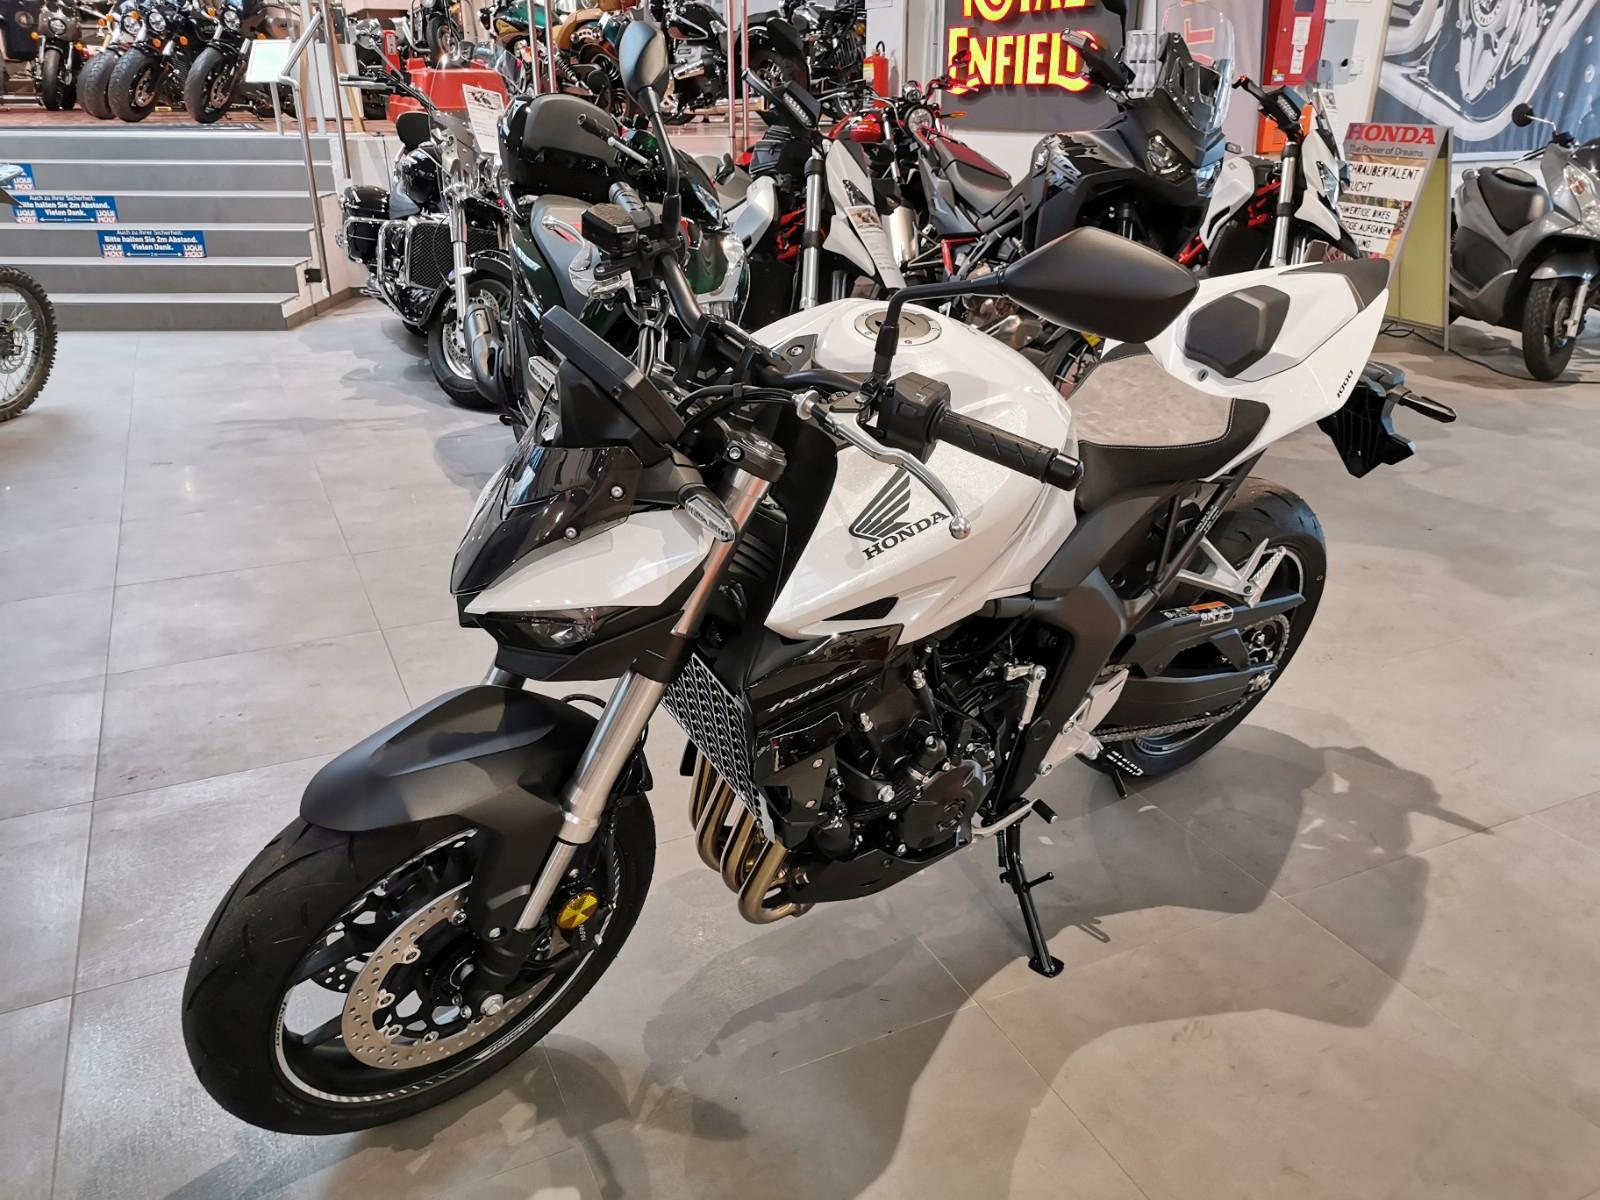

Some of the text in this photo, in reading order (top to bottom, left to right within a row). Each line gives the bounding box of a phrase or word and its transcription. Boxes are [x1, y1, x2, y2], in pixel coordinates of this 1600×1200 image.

[1346, 124, 1436, 145] HONDA
[1363, 145, 1385, 153] Power
[1386, 146, 1395, 155] of
[1396, 147, 1425, 157] Dreams
[45, 208, 67, 216] Vielen
[122, 236, 144, 244] halten
[169, 237, 199, 245] Abstand.
[132, 243, 175, 252] Vielen Dank.
[862, 510, 950, 560] HONDA
